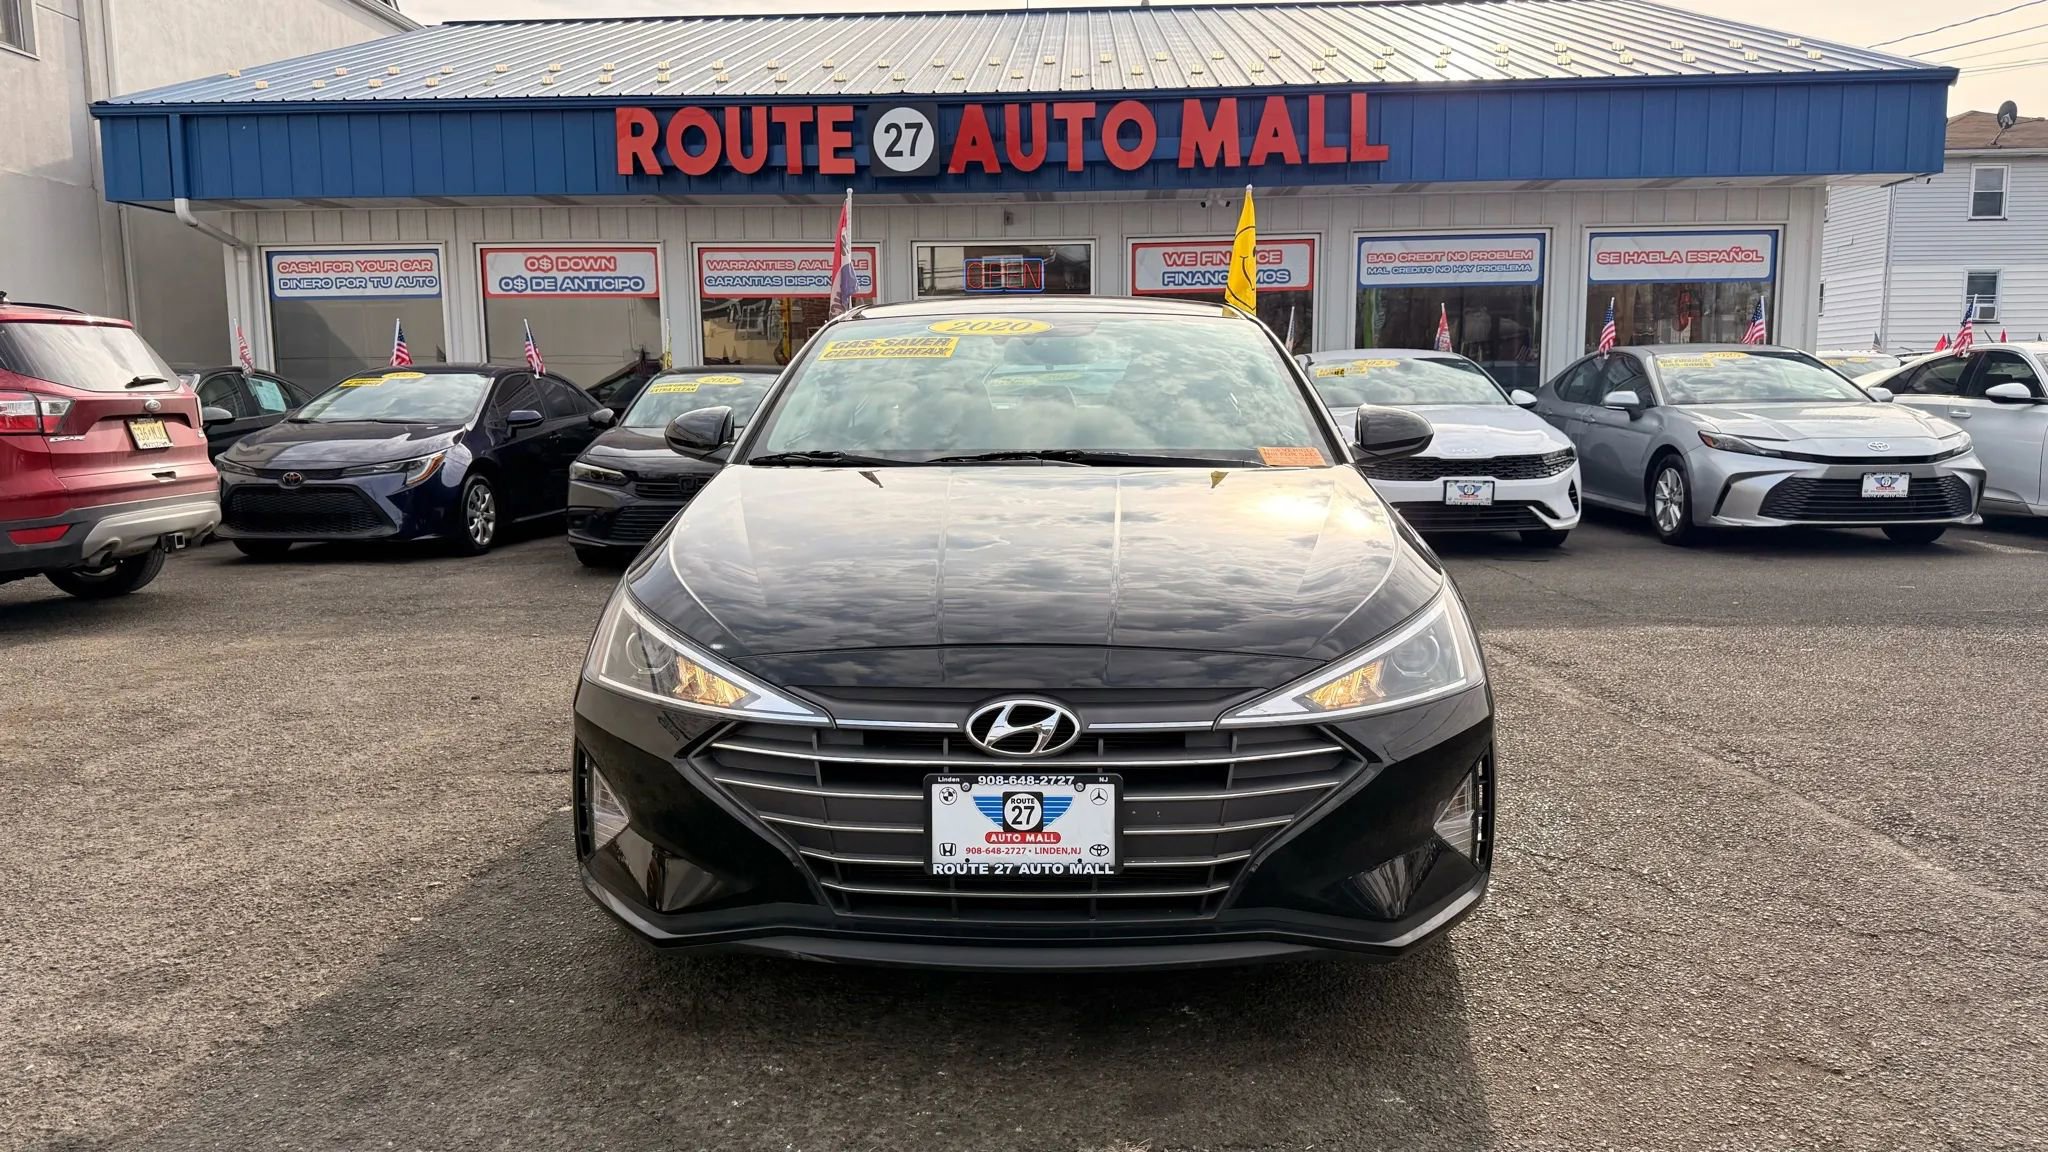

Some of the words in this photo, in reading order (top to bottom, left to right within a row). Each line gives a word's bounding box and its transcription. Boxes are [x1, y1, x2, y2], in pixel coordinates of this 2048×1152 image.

[616, 105, 856, 175] ROUTE
[884, 123, 923, 157] 27
[947, 100, 1157, 174] AUTO
[1178, 92, 1389, 168] MALL
[1163, 252, 1198, 267] WE
[1200, 250, 1283, 266] FINCE
[1367, 252, 1397, 264] BAD
[1398, 251, 1446, 263] CREDIT
[1447, 251, 1469, 262] NO
[1469, 250, 1533, 261] PROBLEM
[1597, 252, 1622, 265] SE
[1623, 250, 1683, 264] HABLA
[1686, 245, 1764, 264] ESPAÑOL
[278, 261, 320, 274] CASH
[322, 260, 353, 273] FOR
[356, 260, 398, 272] YOUR
[401, 259, 433, 272] CAR
[556, 256, 617, 272] DOWN
[706, 259, 795, 271] WARRANTIES
[798, 259, 869, 271] AVAILLE
[1367, 266, 1391, 275] MAL
[1392, 265, 1434, 275] CREDITO
[1435, 265, 1451, 274] NO
[1452, 264, 1475, 274] HAY
[1475, 263, 1532, 273] PROBLEMA
[705, 275, 783, 287] GARANTIAS
[966, 262, 1042, 289] OPEN
[279, 277, 334, 290] DINERO
[335, 277, 367, 289] POR
[369, 276, 392, 288] TU
[395, 276, 438, 288] AUTO
[530, 277, 557, 292] DE
[559, 276, 645, 292] ANTICIPO
[946, 320, 1034, 332] 2020
[823, 348, 878, 358] CLEAN
[880, 347, 950, 358] CARFAX
[978, 776, 1075, 786] 908-648-2727
[1011, 806, 1035, 825] 27
[990, 834, 1021, 843] AUTO
[1026, 834, 1056, 843] MALL
[965, 847, 1026, 855] 908-648-2727
[932, 863, 989, 875] ROUTE
[994, 863, 1014, 874] 27
[1018, 863, 1069, 875] AUTO
[1074, 863, 1114, 875] MALL
